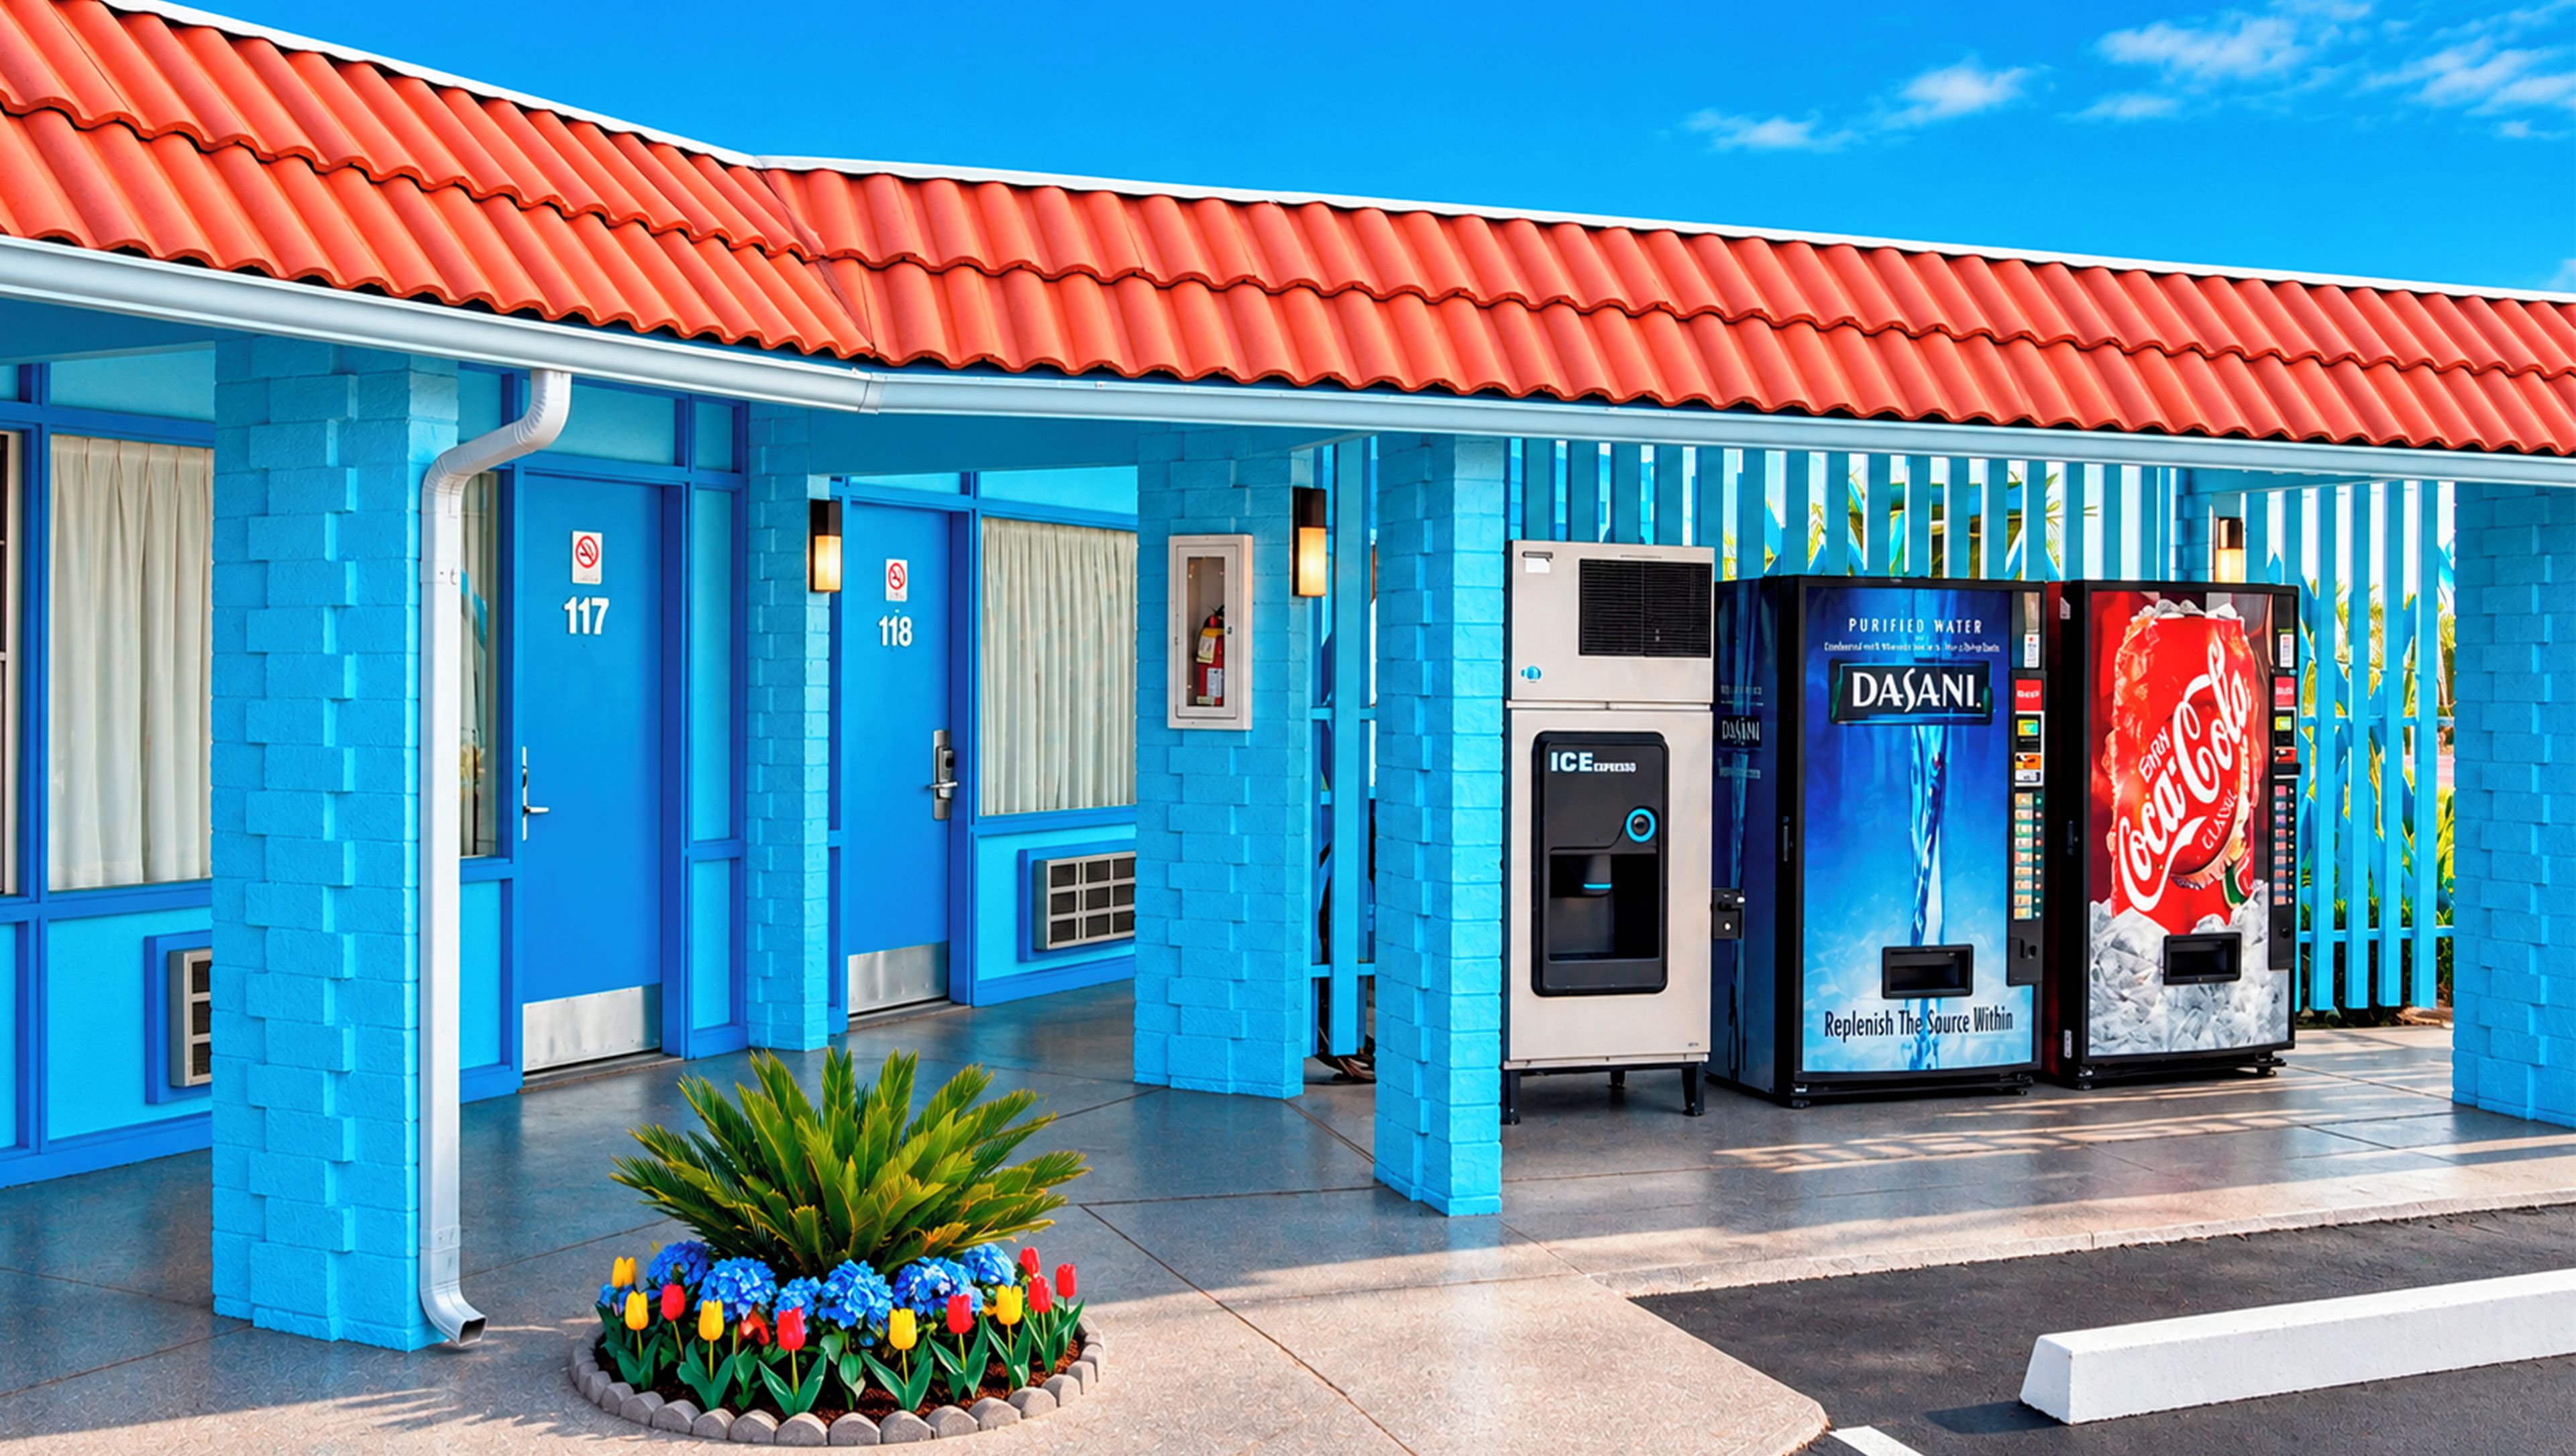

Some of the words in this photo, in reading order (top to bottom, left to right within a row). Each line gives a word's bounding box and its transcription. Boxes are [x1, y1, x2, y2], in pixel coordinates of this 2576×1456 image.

[564, 596, 610, 635] 117
[878, 615, 913, 647] 118
[1848, 617, 1925, 633] PURIFIED
[1934, 619, 1982, 634] WATER
[1550, 751, 1594, 772] ICE
[2118, 631, 2247, 912] Coca-Cola
[1824, 1009, 1894, 1043] Replenish
[1898, 1009, 1923, 1035] The
[1927, 1008, 1970, 1035] Source
[1973, 1004, 2013, 1033] Within
